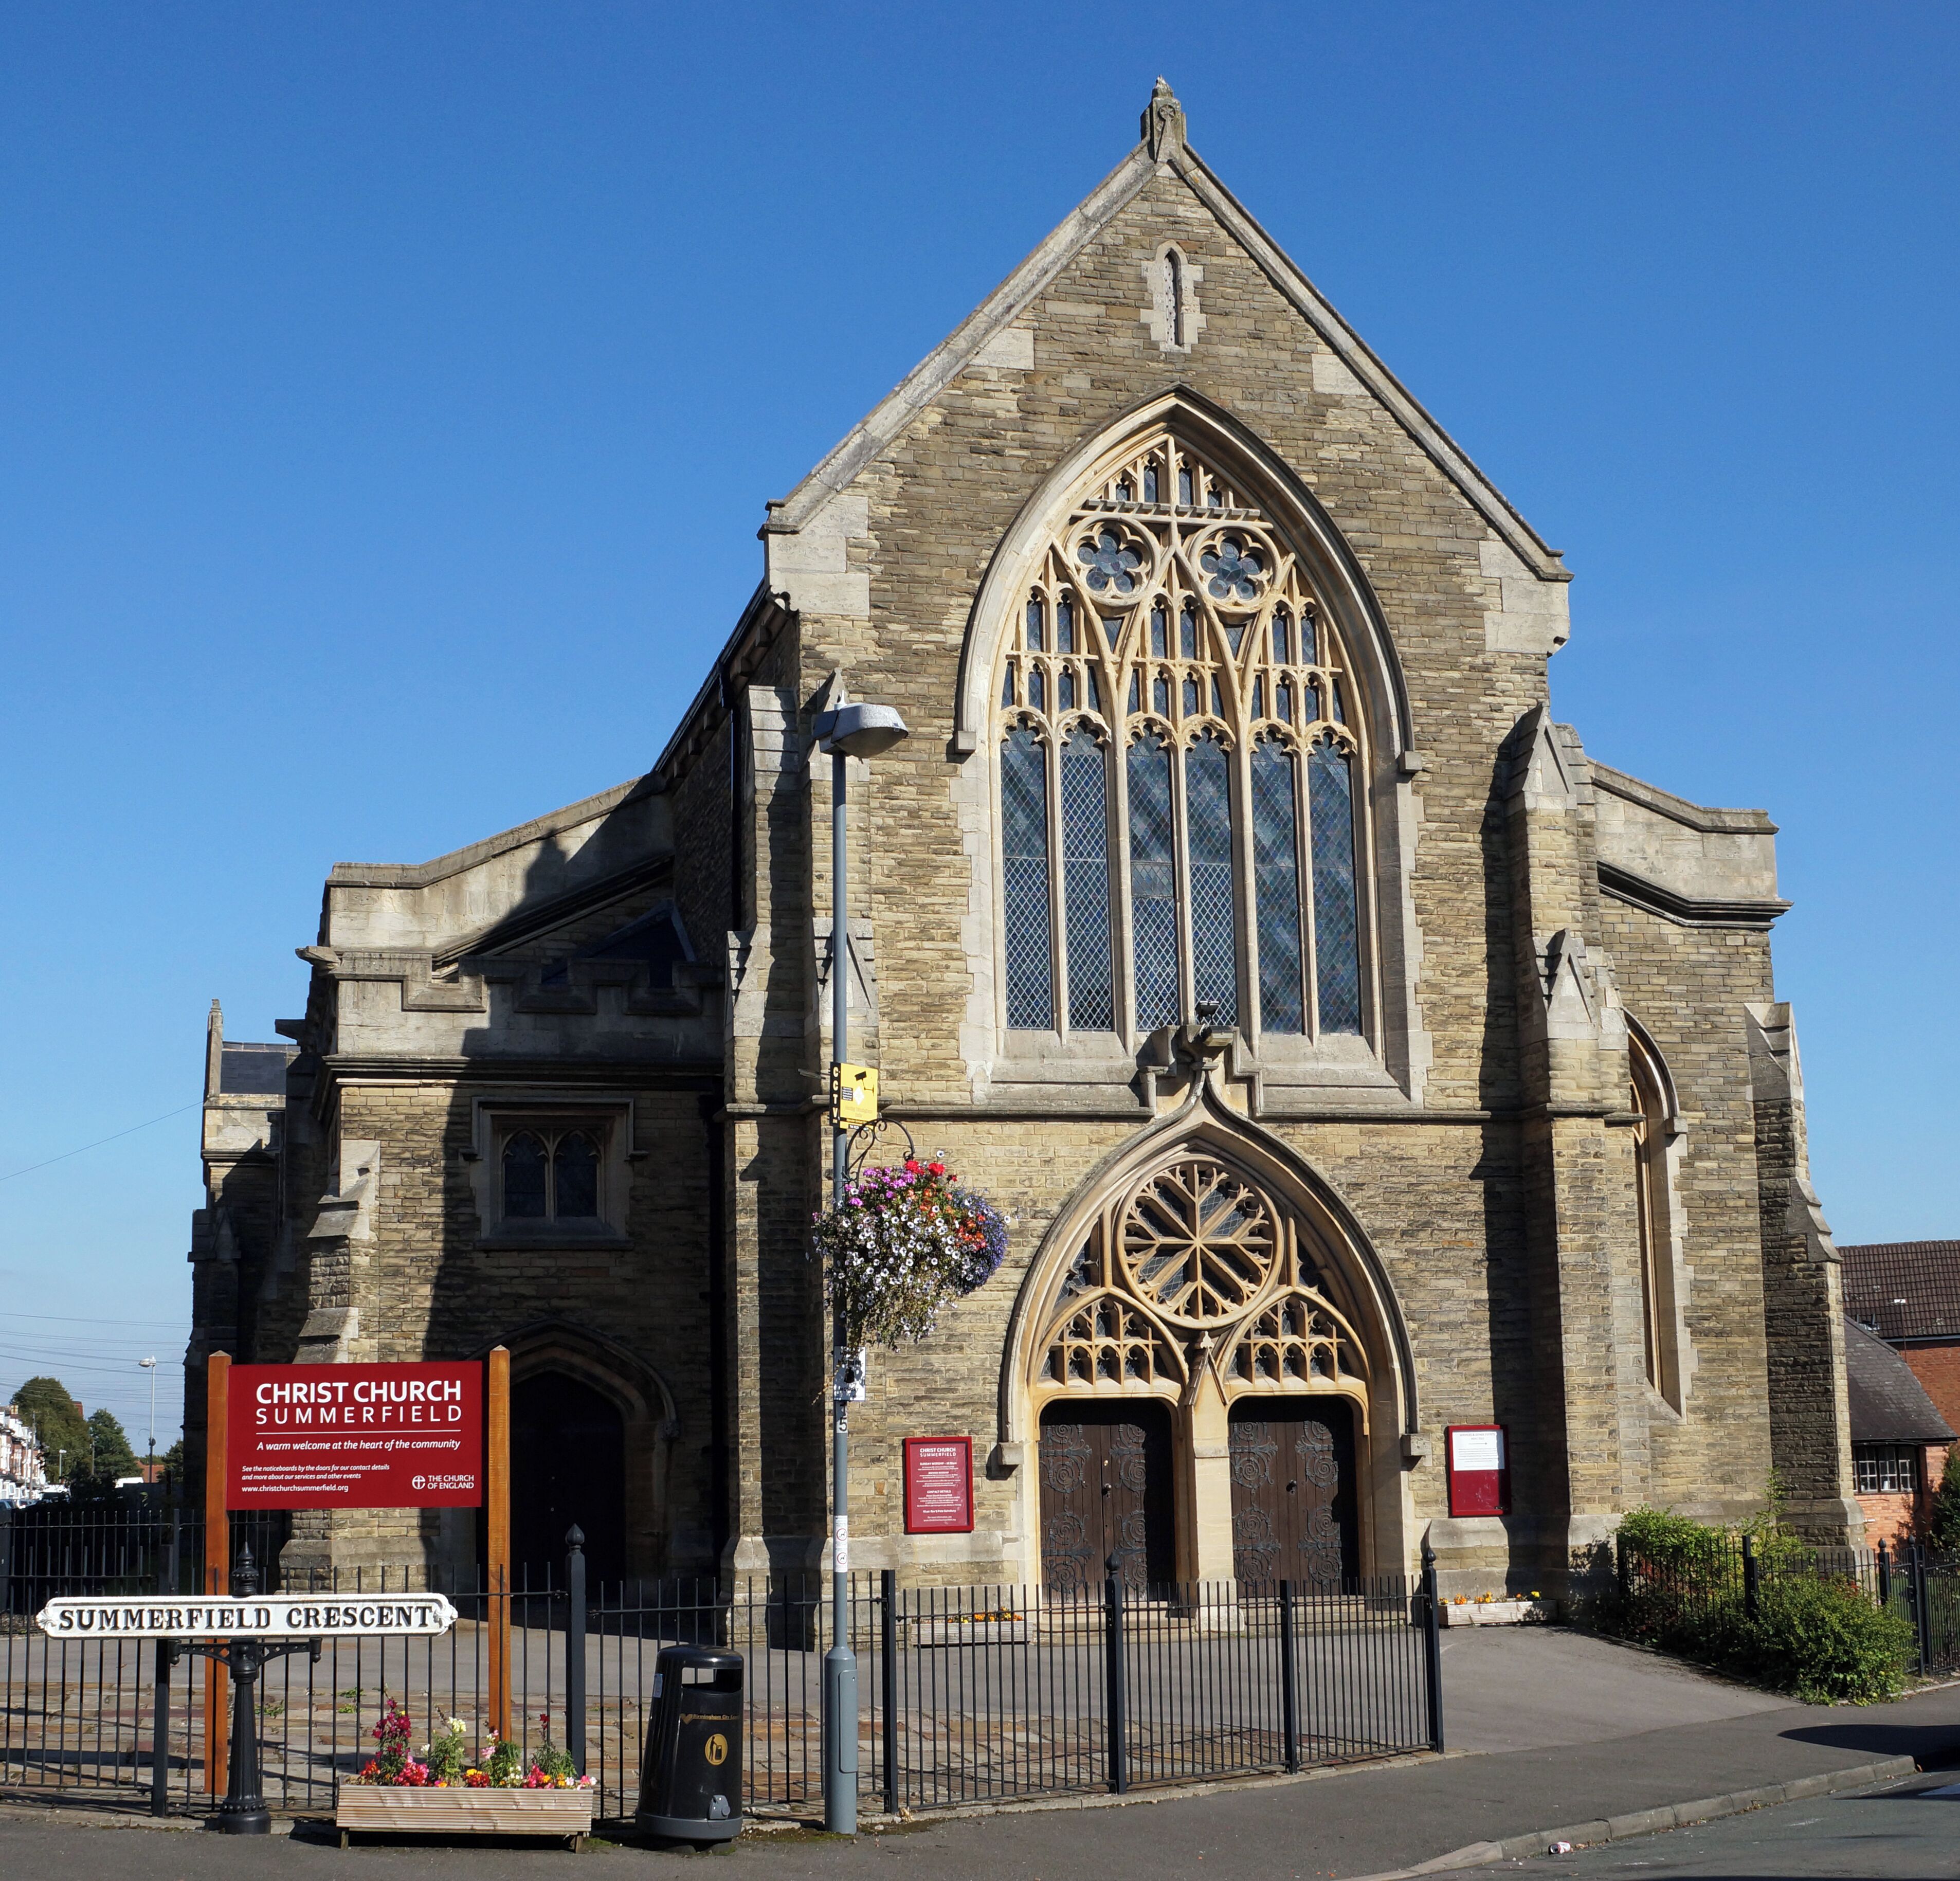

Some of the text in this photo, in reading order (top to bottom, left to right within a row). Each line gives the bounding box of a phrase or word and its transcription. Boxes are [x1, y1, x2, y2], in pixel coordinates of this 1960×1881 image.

[256, 1380, 461, 1404] CHRIST CHURCH
[256, 1405, 461, 1424] SUMMERFIELD
[257, 1441, 264, 1450] A
[293, 1440, 330, 1450] welcome
[332, 1441, 342, 1450] at
[343, 1440, 358, 1450] the
[359, 1440, 383, 1449] heart
[385, 1439, 395, 1451] of
[395, 1439, 410, 1449] the
[411, 1439, 461, 1451] community
[331, 1464, 339, 1472] for
[242, 1484, 349, 1493] www.christchurchsummerfield.org
[59, 1606, 432, 1631] SUMMERFIELD CRESCENT
